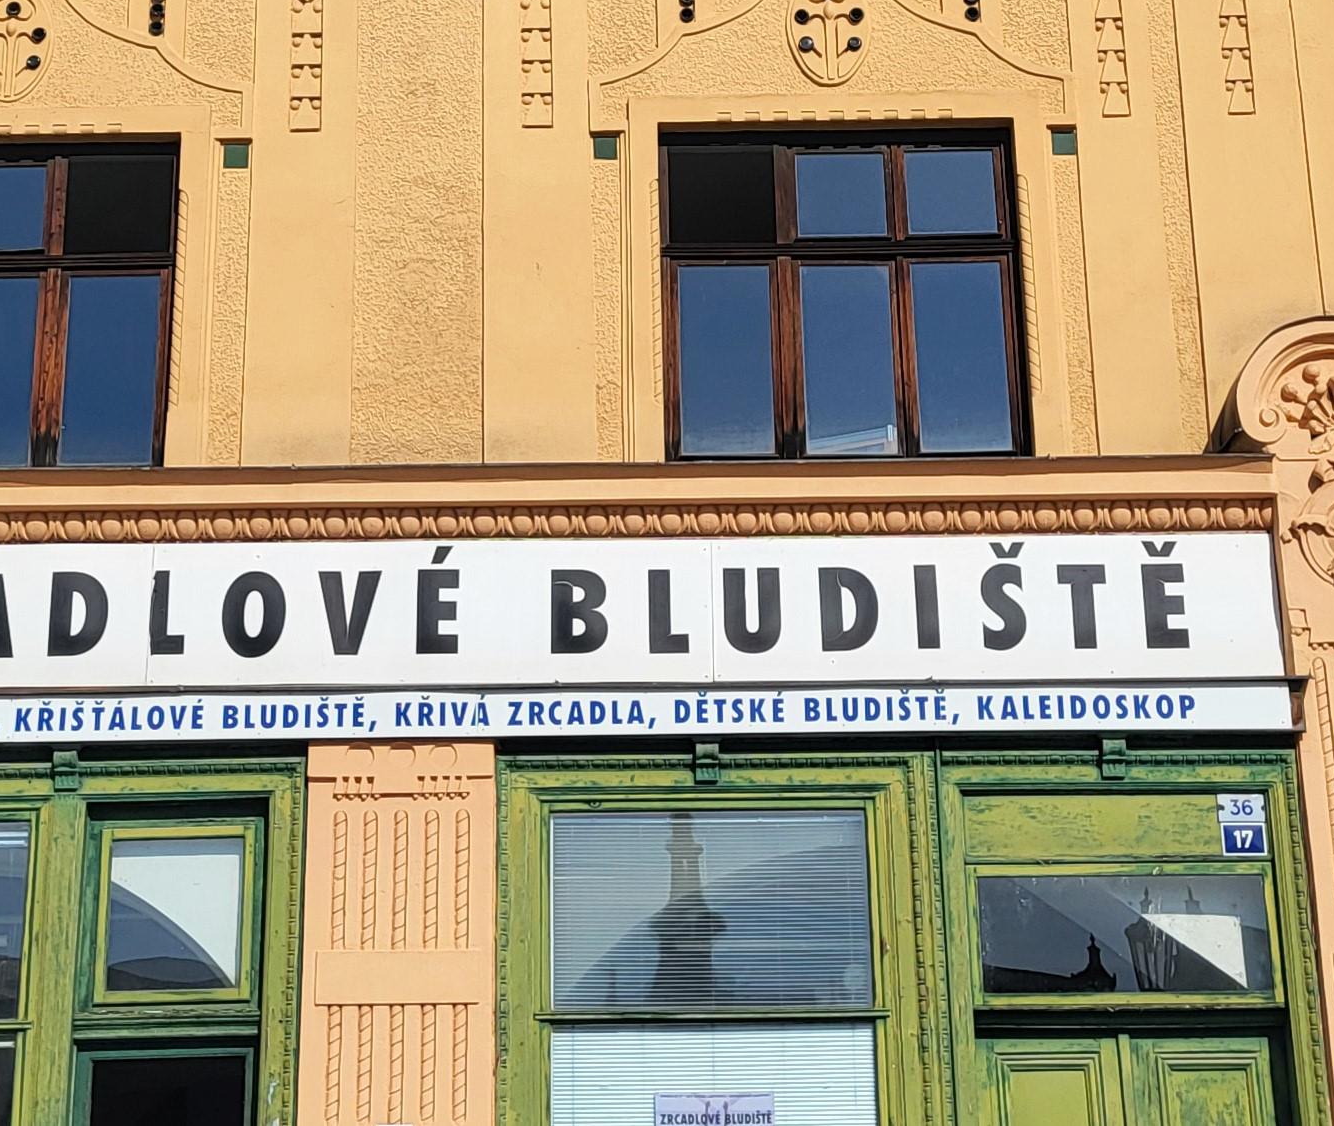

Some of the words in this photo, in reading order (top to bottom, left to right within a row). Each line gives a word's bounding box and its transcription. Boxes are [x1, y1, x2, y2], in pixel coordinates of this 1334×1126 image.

[550, 541, 1191, 655] BLUDIŠTĚ
[14, 699, 205, 732] KŘIŠŤÁLOVÉ
[222, 697, 377, 732] BLUDIŠTĚ,
[395, 694, 490, 727] KŘIVÁ
[507, 699, 656, 729] ZRCADLA,
[674, 691, 785, 724] DĚTSKÉ
[804, 688, 960, 725] BLUDIŠTĚ,
[977, 694, 1196, 721] KALEIDOSKOP
[1229, 799, 1254, 816] 36
[1233, 829, 1254, 849] 17
[660, 1111, 721, 1125] ZRCADLOVÉ
[724, 1110, 772, 1124] BLUDIŠTĚ
